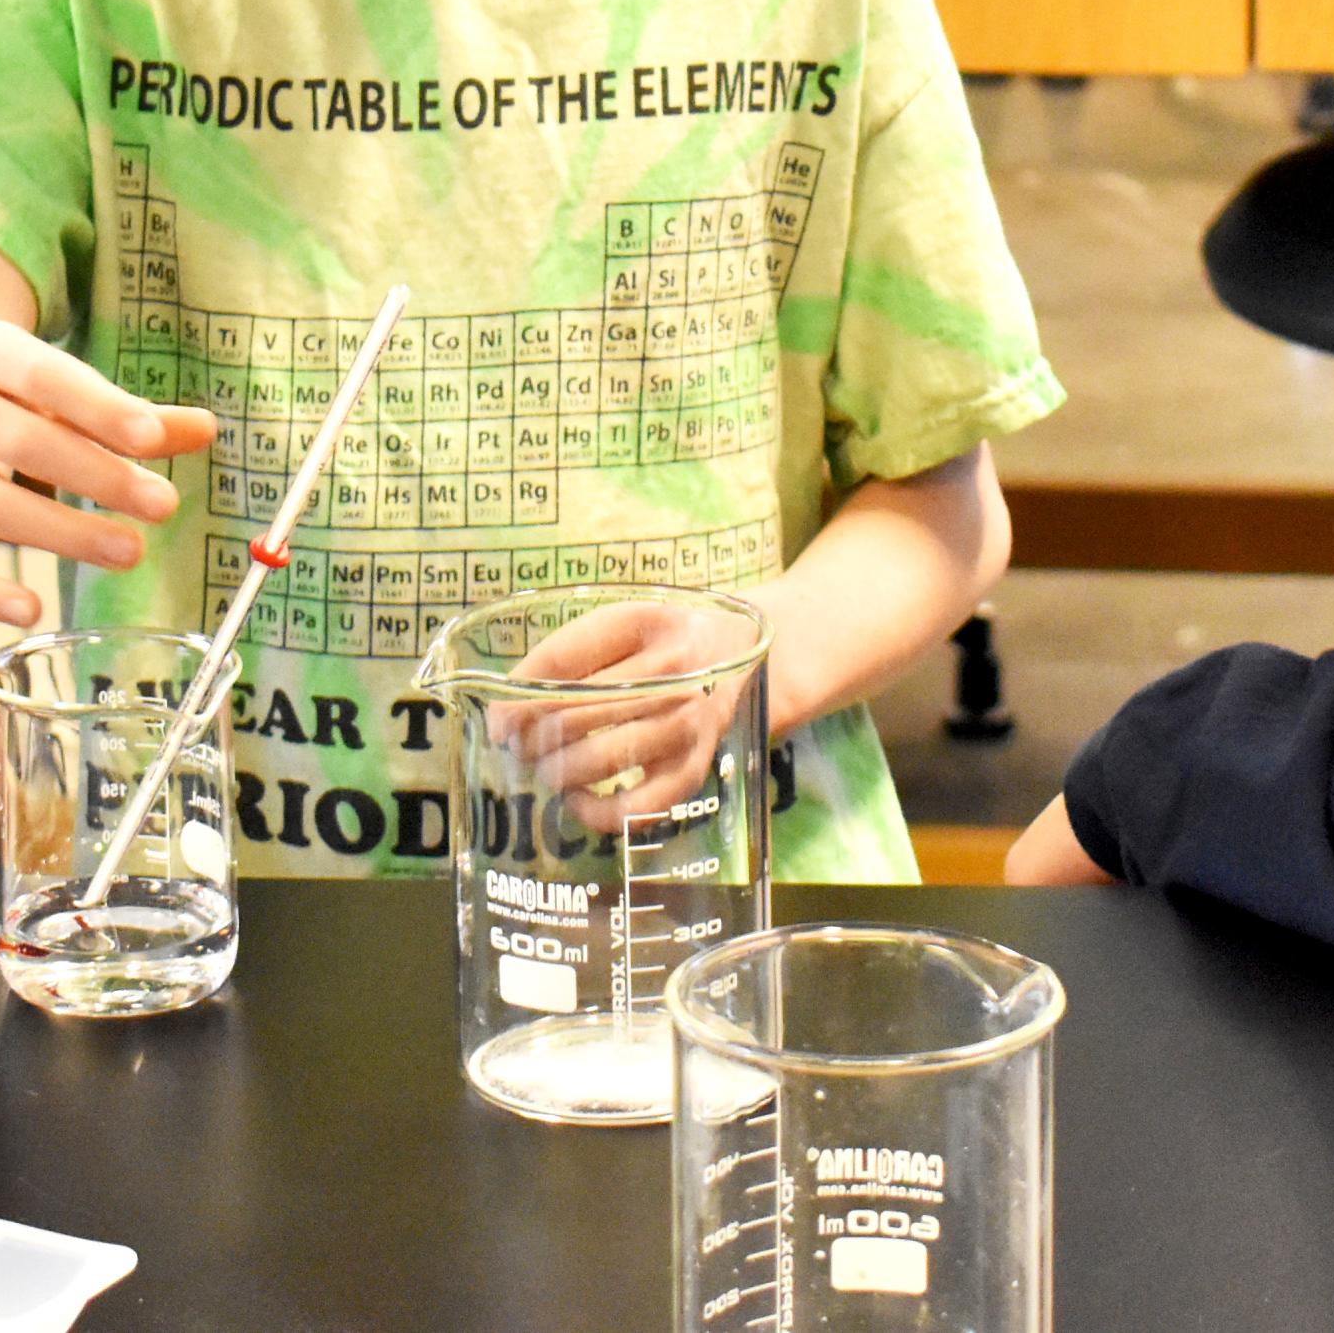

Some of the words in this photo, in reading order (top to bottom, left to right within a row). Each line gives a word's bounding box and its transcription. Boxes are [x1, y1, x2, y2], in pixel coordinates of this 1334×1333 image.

[110, 57, 294, 132] PERIODIC
[304, 78, 441, 133] TABLE
[453, 78, 516, 129] OF
[528, 71, 618, 124] THE
[634, 62, 841, 117] ELEMENTS
[120, 159, 132, 176] H
[782, 156, 811, 178] He
[620, 218, 634, 239] B
[663, 216, 677, 236] C
[700, 216, 712, 233] N
[729, 212, 743, 231] O
[771, 205, 797, 227] Ne
[147, 262, 176, 286] Mg
[615, 271, 637, 290] Al
[659, 269, 675, 288] Si
[698, 266, 706, 284] P
[727, 263, 735, 282] S
[146, 314, 171, 334] Ca
[218, 328, 237, 347] Ti
[263, 333, 277, 350] V
[302, 333, 326, 352] Cr
[388, 333, 414, 351] Fe
[431, 331, 460, 350] Co
[479, 328, 502, 347] Ni
[521, 325, 549, 344] Cu
[566, 324, 593, 342] Zn
[607, 322, 637, 341] Ga
[651, 321, 678, 339] Ge
[687, 318, 707, 335] As
[146, 368, 166, 385] Sr
[215, 380, 236, 398] Zr
[252, 383, 283, 402] Nb
[296, 385, 331, 404] Mo
[385, 385, 414, 404] Ru
[431, 382, 459, 403] Rh
[476, 380, 504, 399] Pd
[520, 377, 551, 399] Ag
[566, 376, 592, 395] Cd
[610, 375, 630, 393] In
[650, 373, 673, 393] Sn
[686, 370, 706, 388] Sb
[254, 433, 276, 451] Ta
[344, 435, 368, 453] Re
[385, 434, 413, 453] Os
[436, 434, 452, 450] Ir
[478, 431, 500, 449] Pt
[518, 428, 549, 447] Au
[563, 426, 592, 448] Hg
[610, 425, 627, 442] Tl
[646, 424, 671, 442] Pb
[686, 420, 704, 439] Bi
[717, 417, 735, 433] Po
[219, 474, 237, 494] Rf
[250, 481, 278, 500] Db
[308, 489, 320, 507] g
[339, 486, 367, 504] Bh
[384, 486, 412, 505] Hs
[427, 484, 458, 503] Mt
[473, 483, 503, 502] Ds
[519, 481, 548, 504] Rg
[218, 548, 240, 568] La
[296, 560, 317, 579] Pr
[332, 564, 364, 583] Nd
[376, 566, 412, 584] Pm
[423, 564, 459, 584] Sm
[473, 563, 500, 582] Eu
[517, 560, 549, 580] Gd
[563, 558, 589, 577] Tb
[602, 554, 629, 575] Dy
[642, 553, 668, 572] Ho
[681, 549, 699, 568] Er
[215, 597, 230, 616] A
[255, 602, 277, 623] Th
[292, 608, 317, 628] Pa
[339, 613, 355, 631] U
[376, 614, 411, 636] Np
[670, 796, 719, 821] 500
[672, 857, 720, 881] 400
[486, 902, 589, 928] www.carolina.com
[673, 918, 722, 944] 300
